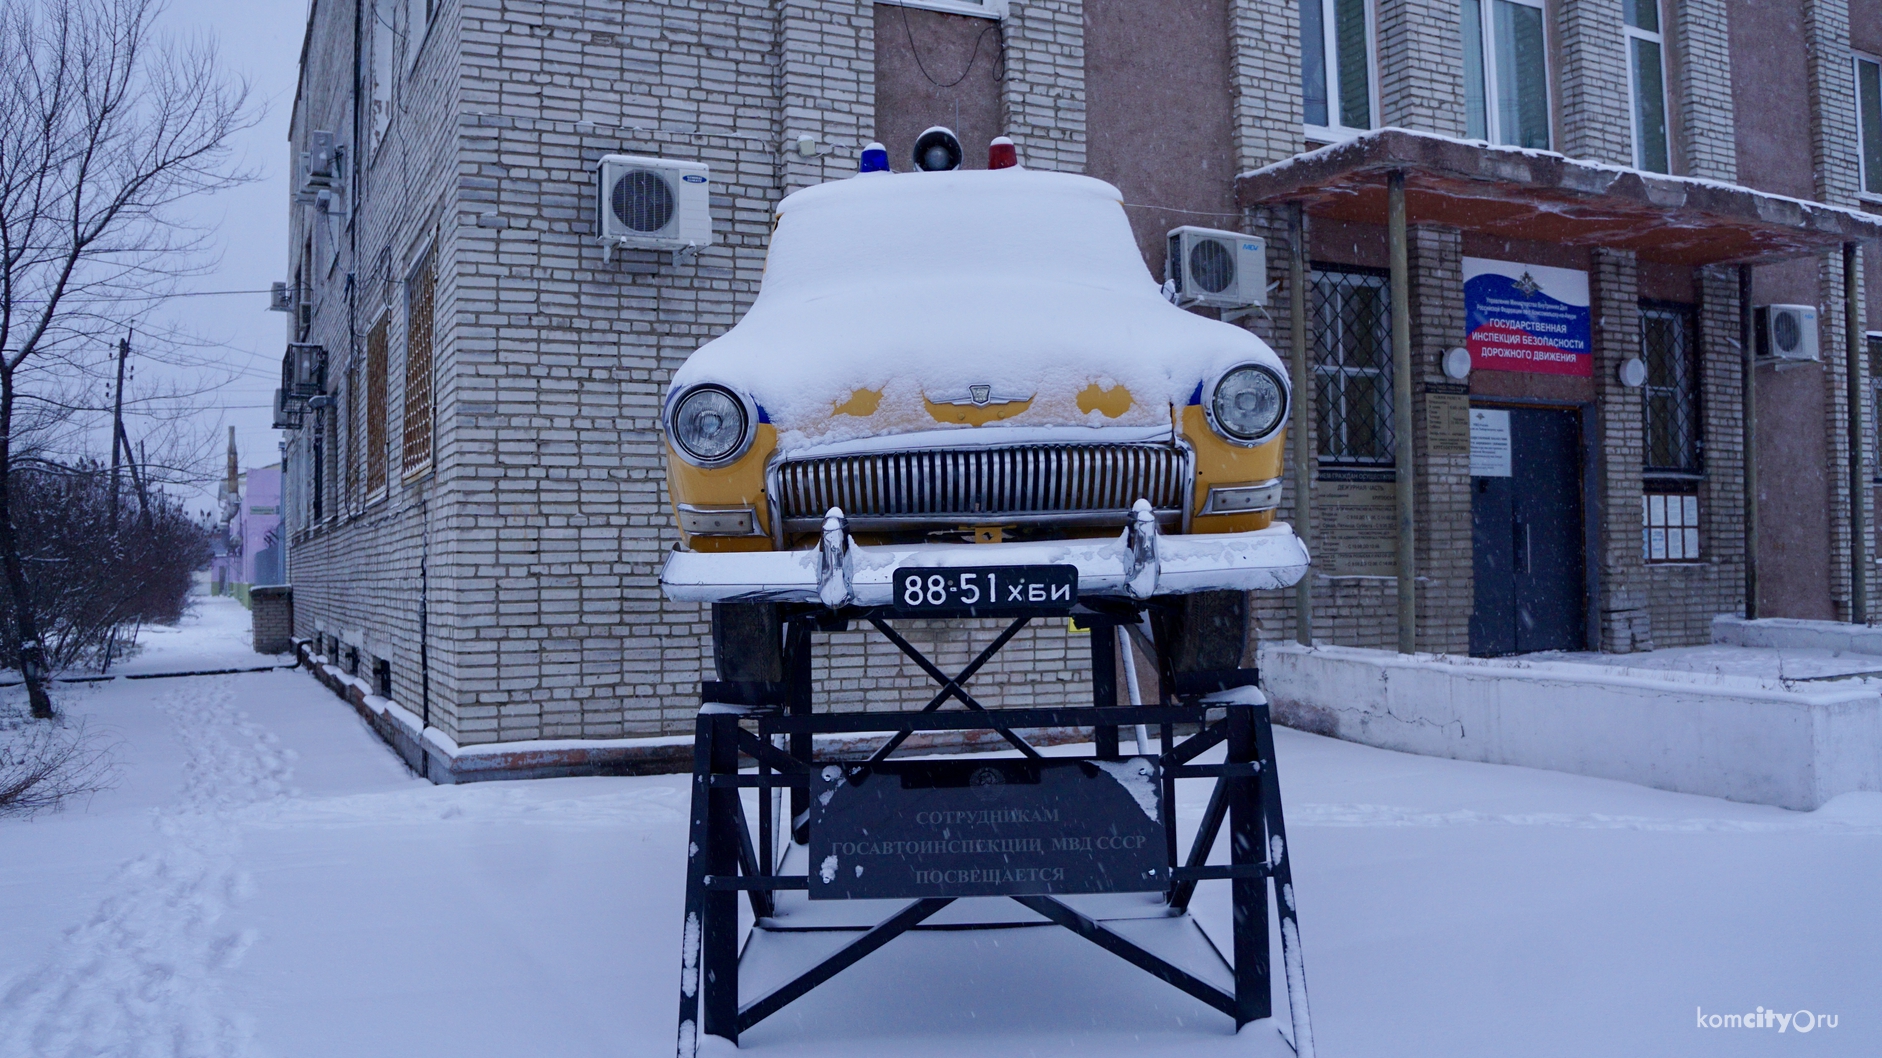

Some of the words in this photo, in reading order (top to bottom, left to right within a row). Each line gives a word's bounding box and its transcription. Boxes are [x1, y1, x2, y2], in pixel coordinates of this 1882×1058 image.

[1489, 318, 1567, 334] ГОСУДАРСТВЕННАЯ
[1472, 331, 1521, 344] ИНСПЕКЦИЯ
[1522, 335, 1584, 349] БЕЗОПАСНОСТИ
[1481, 347, 1531, 360] ДОРОЖНОГО
[1533, 350, 1577, 363] ДВИЖЕНИЯ
[904, 573, 996, 606] 88-51
[916, 808, 1060, 825] СОТРУДНИКАМ
[831, 838, 1042, 856] ГОСАВТОИНСПЕКЦИИ
[1052, 837, 1093, 852] МВД
[1096, 835, 1147, 850] СССР
